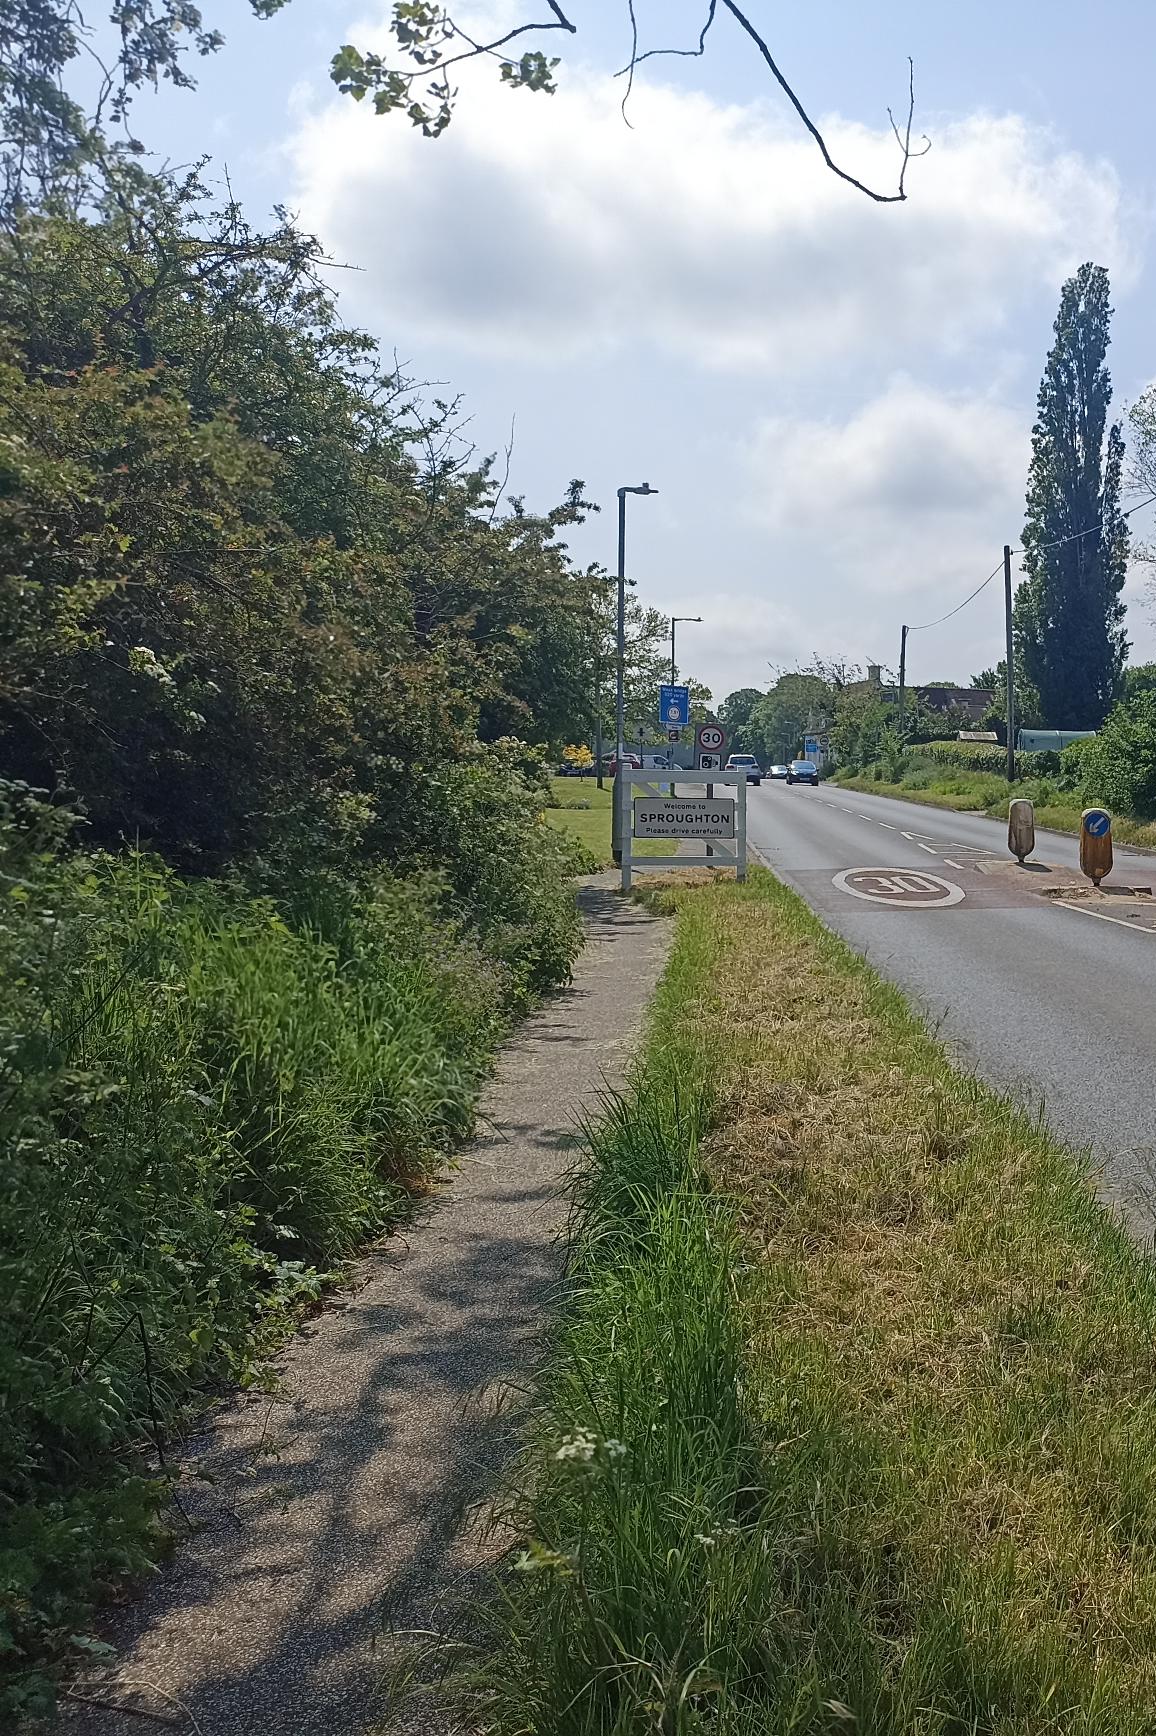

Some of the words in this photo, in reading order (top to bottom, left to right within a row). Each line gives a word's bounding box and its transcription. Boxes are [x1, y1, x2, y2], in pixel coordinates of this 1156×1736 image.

[703, 732, 720, 743] 30
[640, 813, 730, 824] SPROUGHTON
[853, 875, 941, 894] 30
